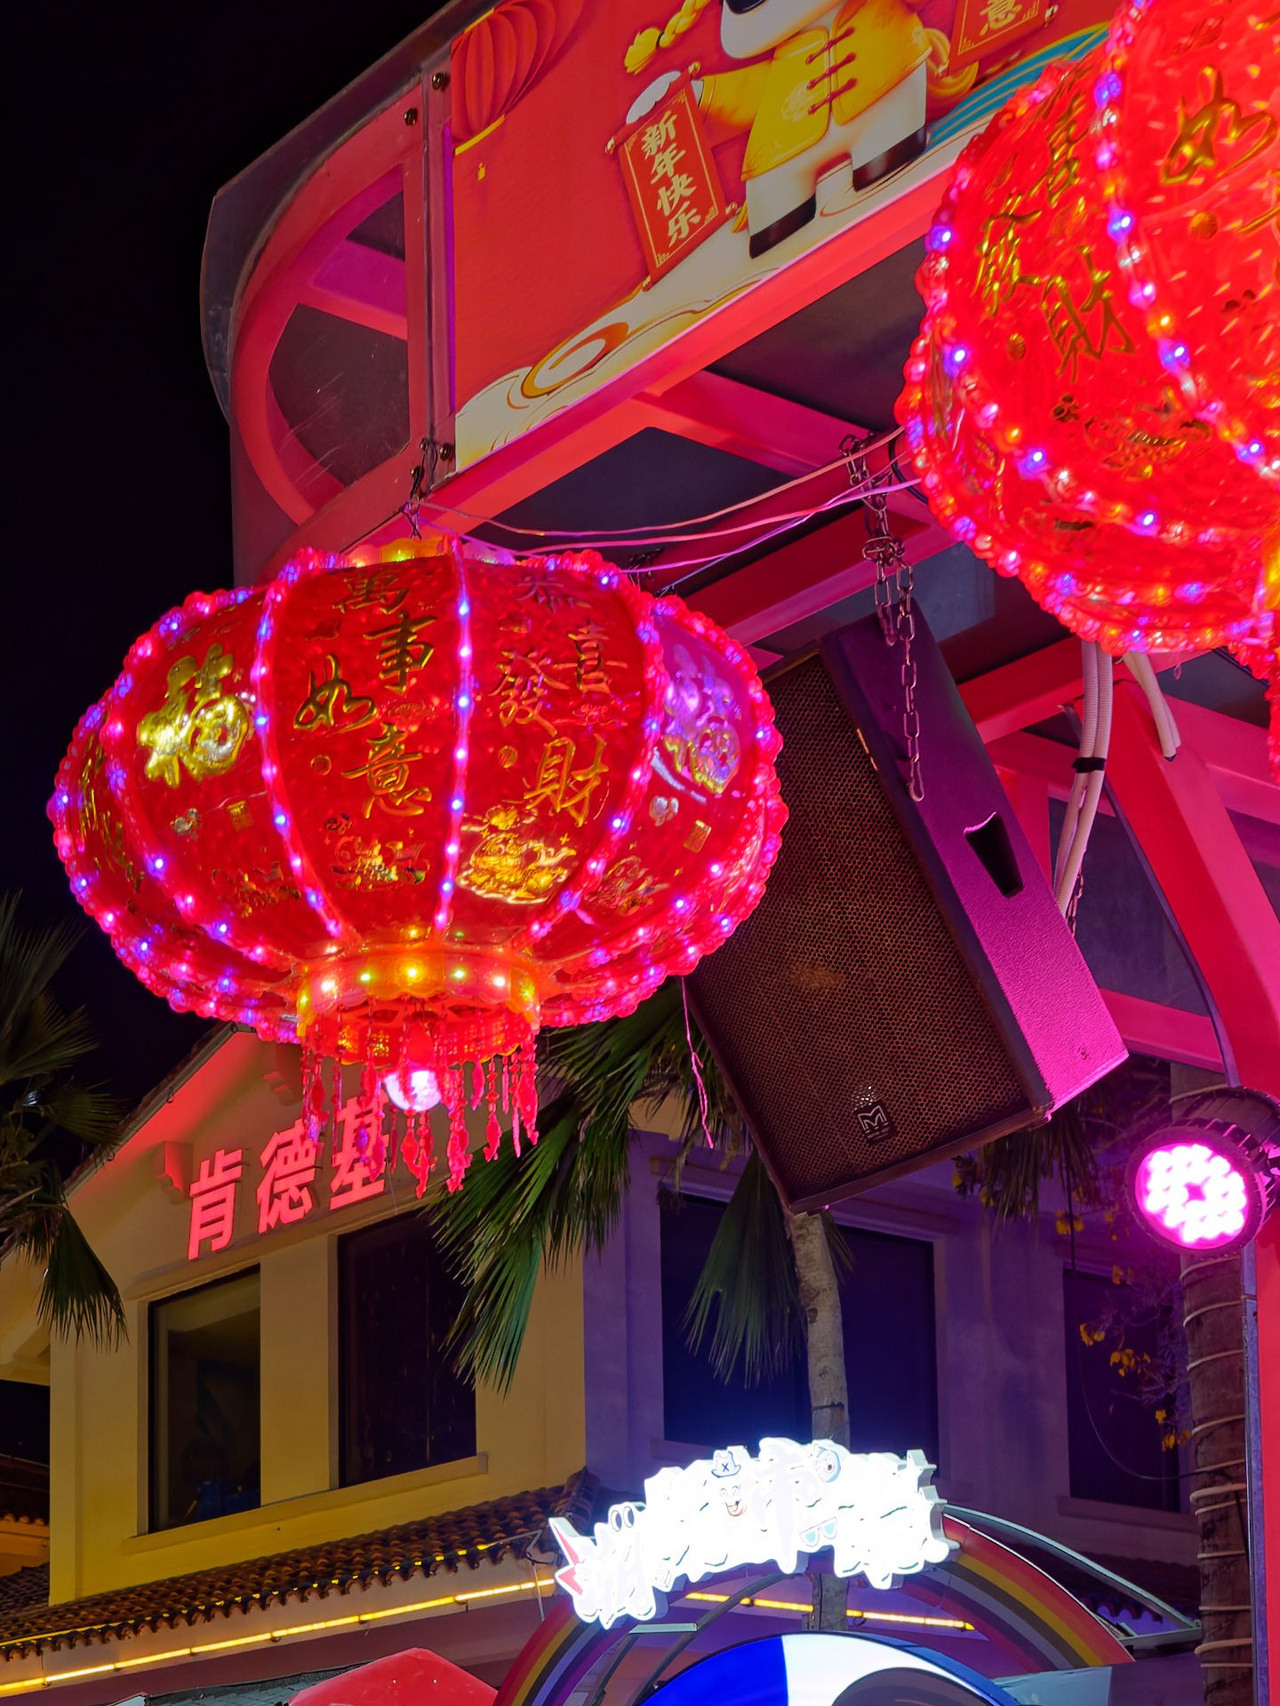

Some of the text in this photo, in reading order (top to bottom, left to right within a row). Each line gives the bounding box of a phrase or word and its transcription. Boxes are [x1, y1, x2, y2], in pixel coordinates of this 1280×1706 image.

[640, 110, 702, 248] 新年快乐
[187, 1094, 391, 1262] 肯德基
